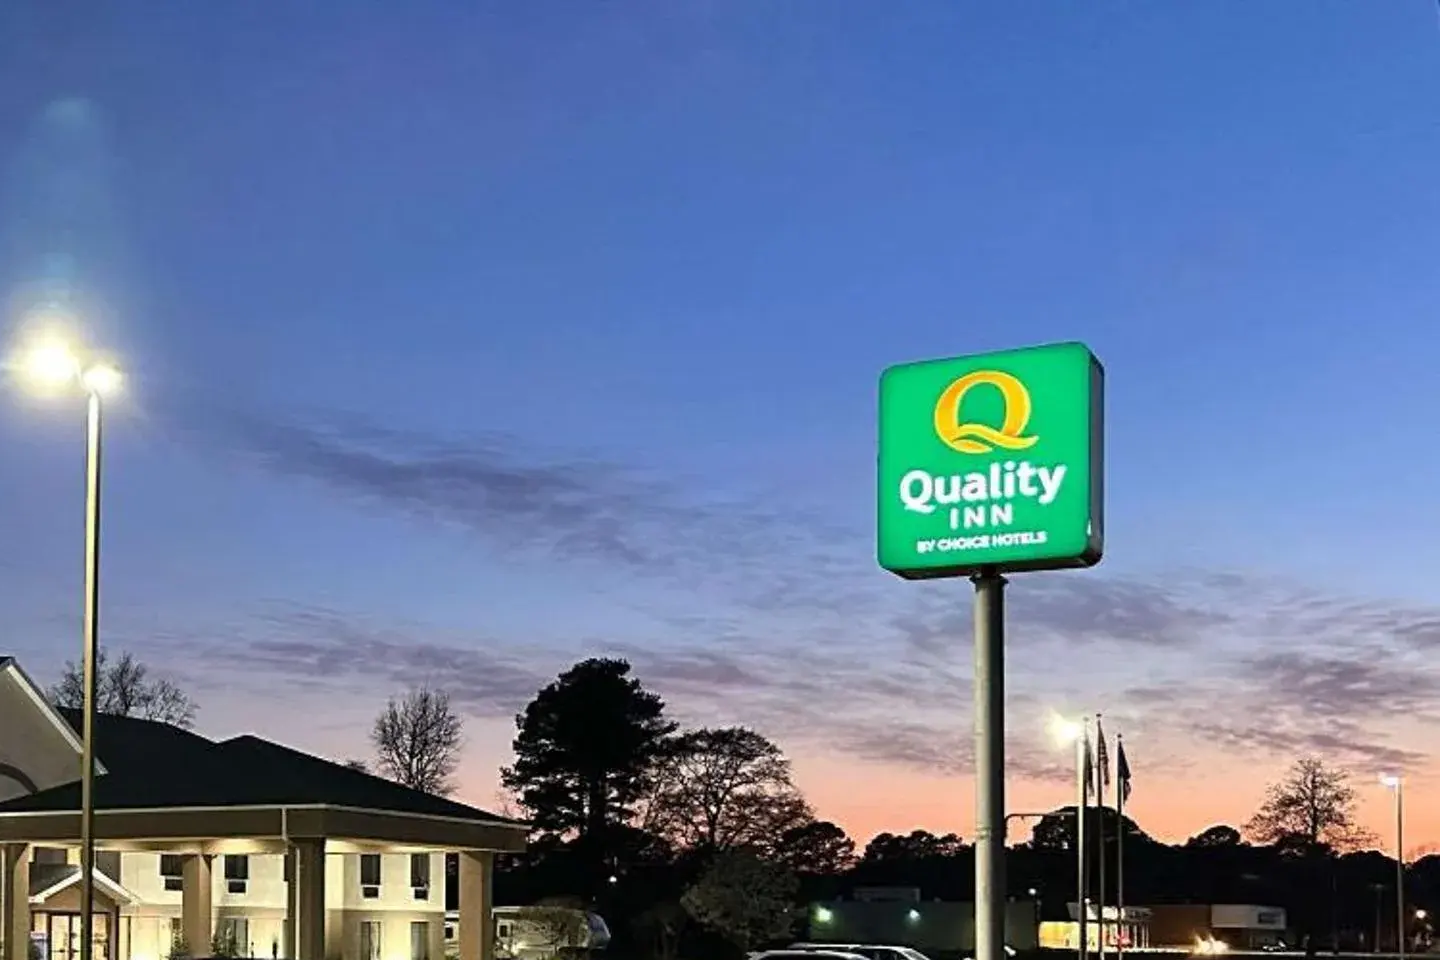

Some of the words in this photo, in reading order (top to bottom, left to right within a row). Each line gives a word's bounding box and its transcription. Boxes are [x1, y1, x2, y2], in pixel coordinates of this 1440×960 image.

[934, 369, 1040, 454] Q
[898, 460, 1068, 514] Quality
[949, 503, 1014, 530] INN
[916, 539, 936, 554] BY
[937, 535, 990, 552] CHOICE
[991, 530, 1048, 548] HOTELS
